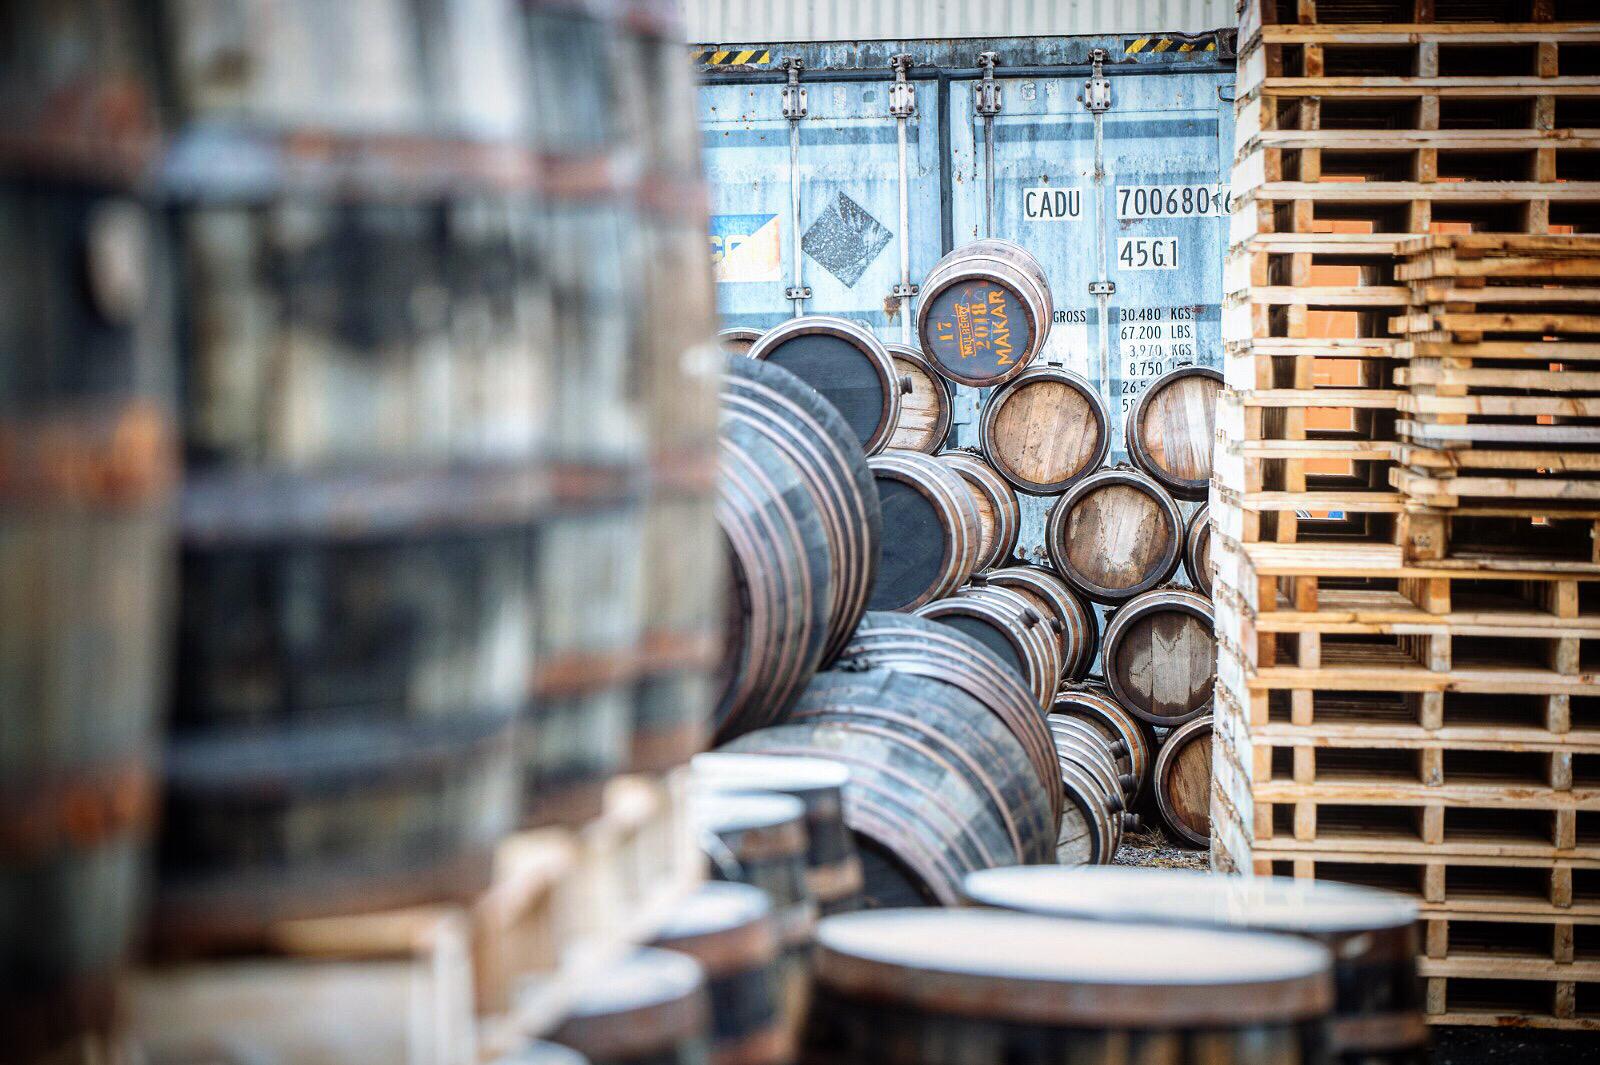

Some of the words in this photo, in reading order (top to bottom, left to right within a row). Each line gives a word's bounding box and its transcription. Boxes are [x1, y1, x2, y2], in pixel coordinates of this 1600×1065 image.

[1025, 190, 1080, 218] CADU
[1118, 187, 1210, 216] 700680
[1119, 240, 1177, 267] 45G1
[971, 303, 991, 350] 2018
[988, 290, 1014, 366] MAKAR
[1053, 310, 1086, 323] GROSS
[1120, 308, 1161, 321] 30.480
[1120, 325, 1162, 340] 67.200
[1129, 361, 1163, 376] 8.750
